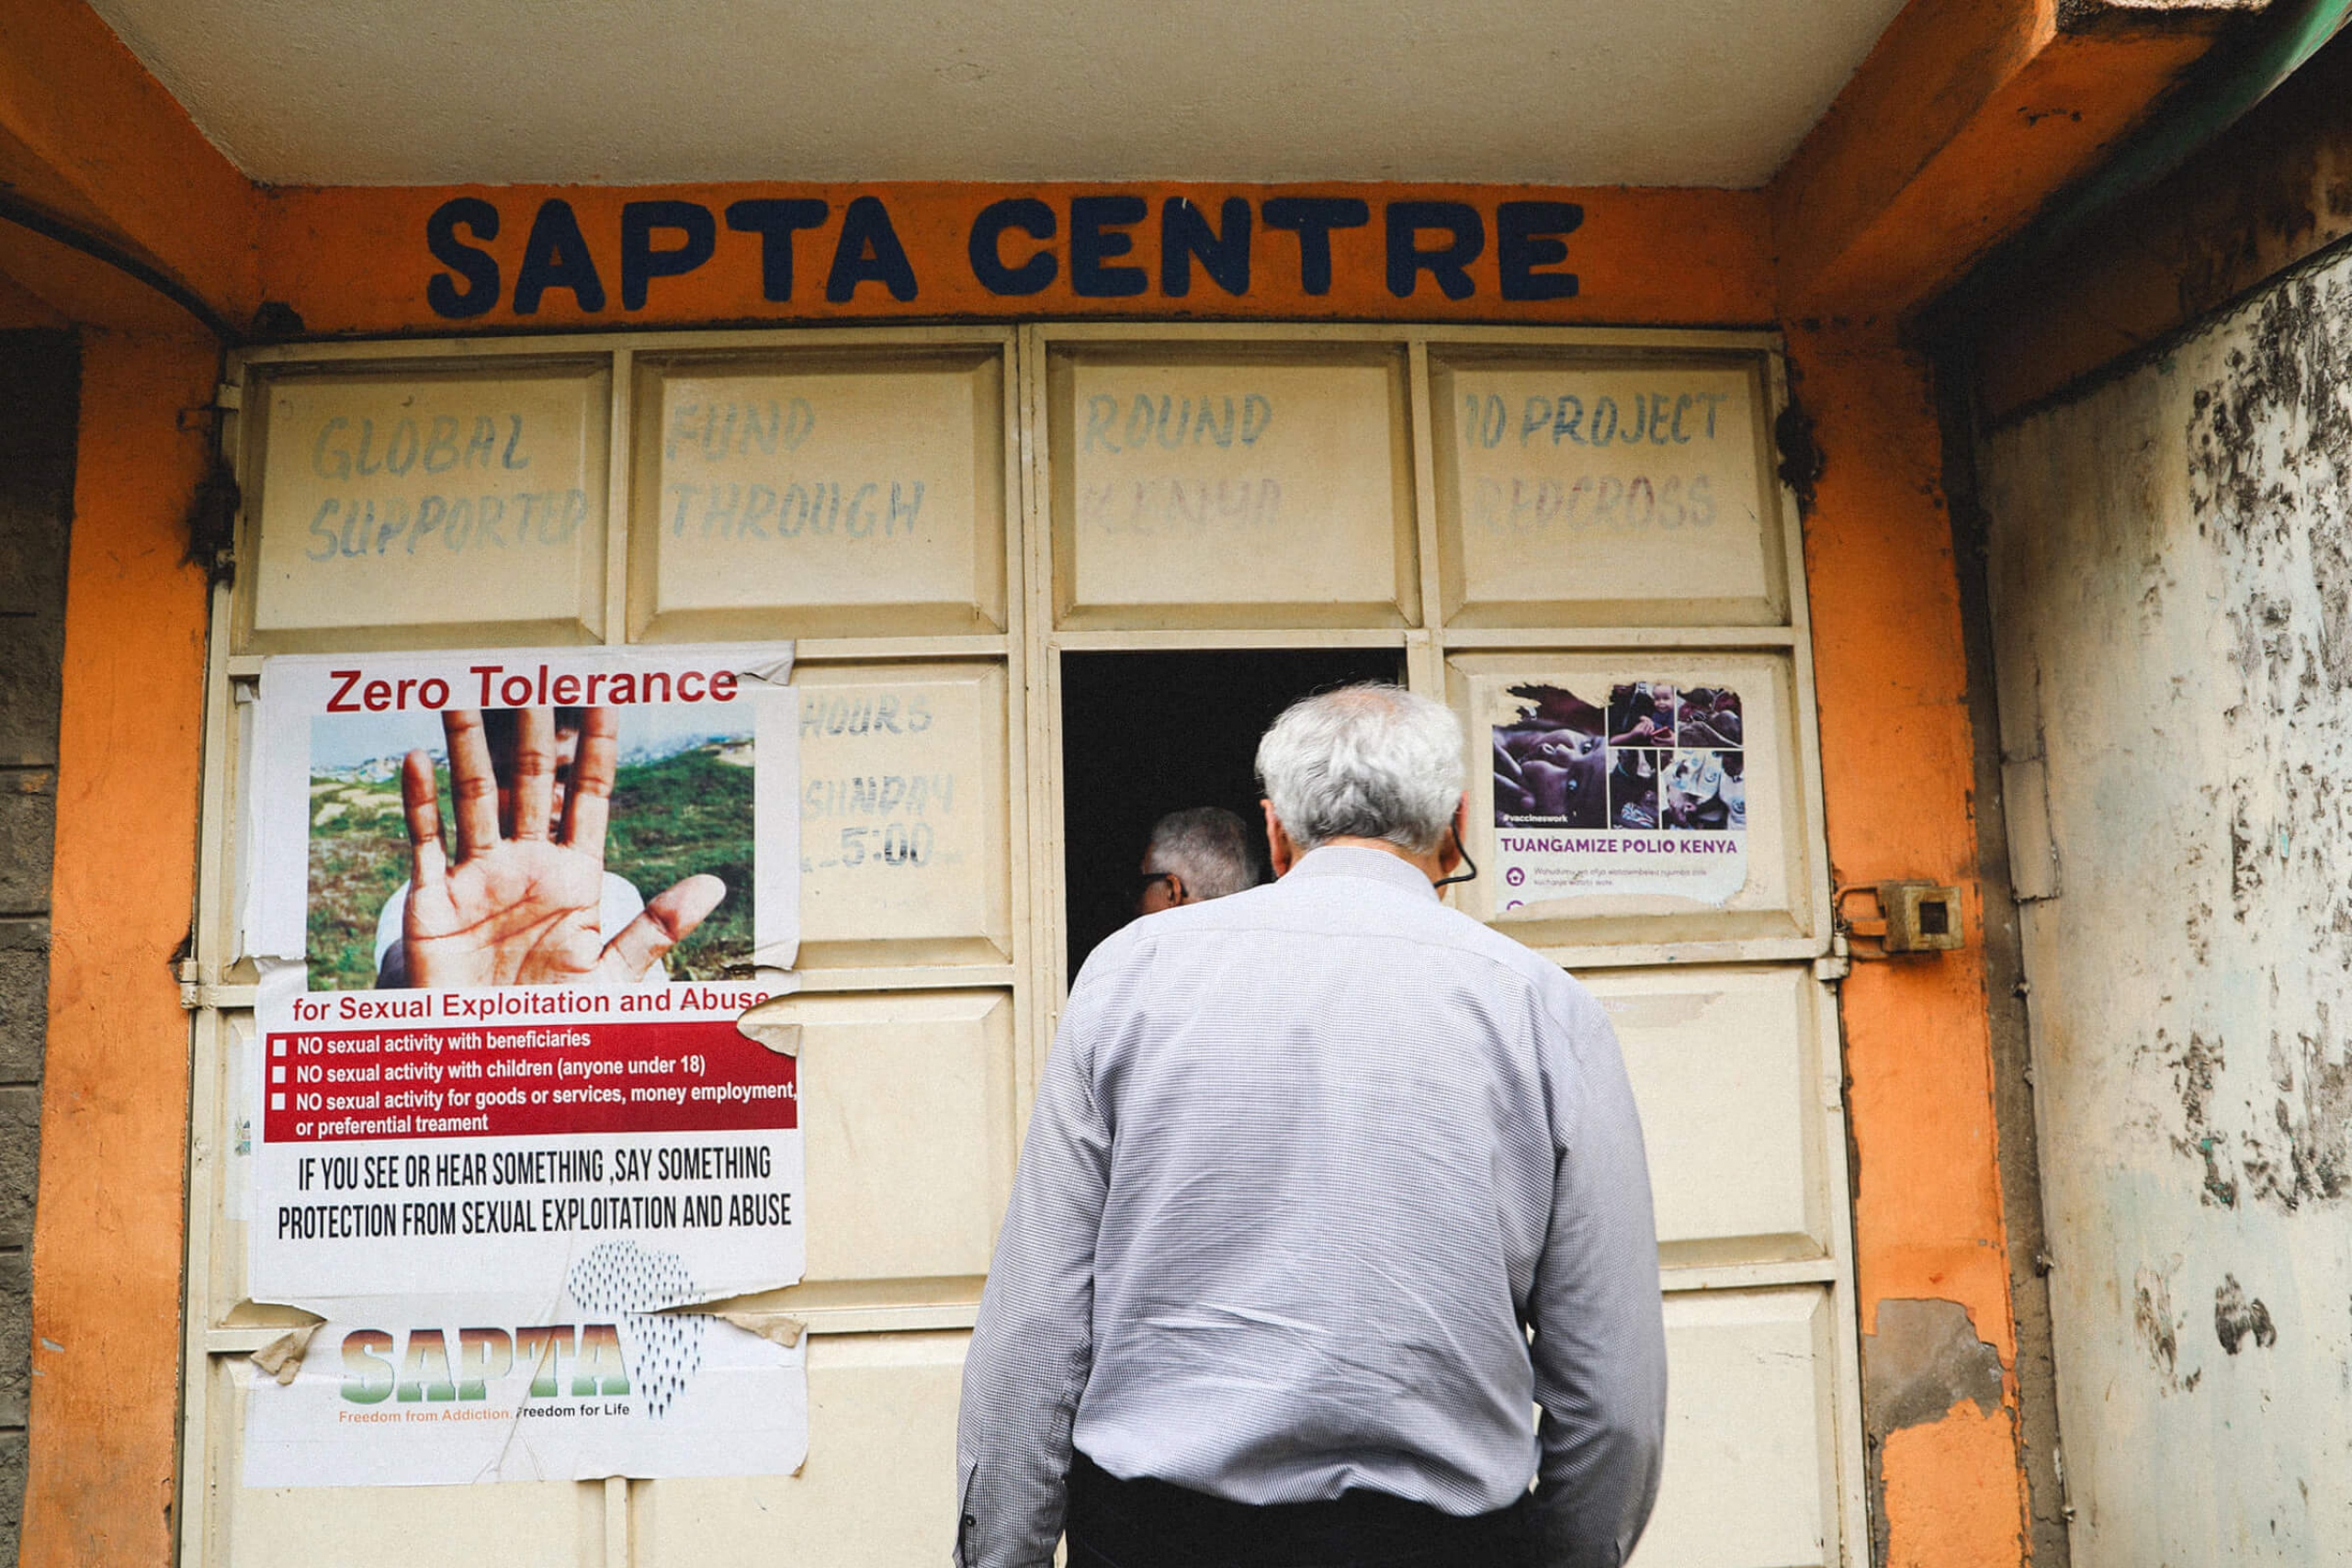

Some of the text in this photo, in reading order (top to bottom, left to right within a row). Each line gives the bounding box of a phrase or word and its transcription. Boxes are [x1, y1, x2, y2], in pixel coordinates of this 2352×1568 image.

[426, 196, 1583, 319] SAPTA CENTRE
[311, 391, 1728, 482] GLOBAL FUND ROUND 10 PROJECT
[305, 488, 588, 563] SUPPORTED
[672, 480, 925, 541] THROUGH
[326, 665, 738, 713] Zero Tolerance
[799, 694, 933, 737] HOURS
[1500, 838, 1737, 853] TUANGAMIZE POLIO KENYA
[292, 998, 329, 1021] for
[339, 994, 431, 1020] Sexual
[442, 990, 610, 1021] Exploitation
[620, 988, 673, 1013] and
[297, 1029, 591, 1055] NO sexual activity with beneficiaries
[296, 1055, 706, 1083] NO sexual activity with children (anyone under 18)
[296, 1081, 797, 1111] NO sexual activity for goods or services, money employment,
[296, 1113, 489, 1140] or preferential treament
[299, 1157, 316, 1191] IF
[322, 1156, 358, 1190] YOU
[364, 1156, 400, 1189] SEE
[405, 1155, 430, 1187] OR
[436, 1154, 487, 1187] HEAR
[492, 1149, 604, 1185] SOMETHING
[658, 1145, 771, 1180] SOMETHING
[278, 1192, 792, 1239] PROTECTION FROM SEXUAL EXPLOITATION AND ABUSE
[340, 1323, 631, 1405] SAPTA
[339, 1410, 401, 1423] Freedom
[405, 1409, 438, 1422] from
[581, 1404, 600, 1416] for
[605, 1404, 630, 1416] Life
